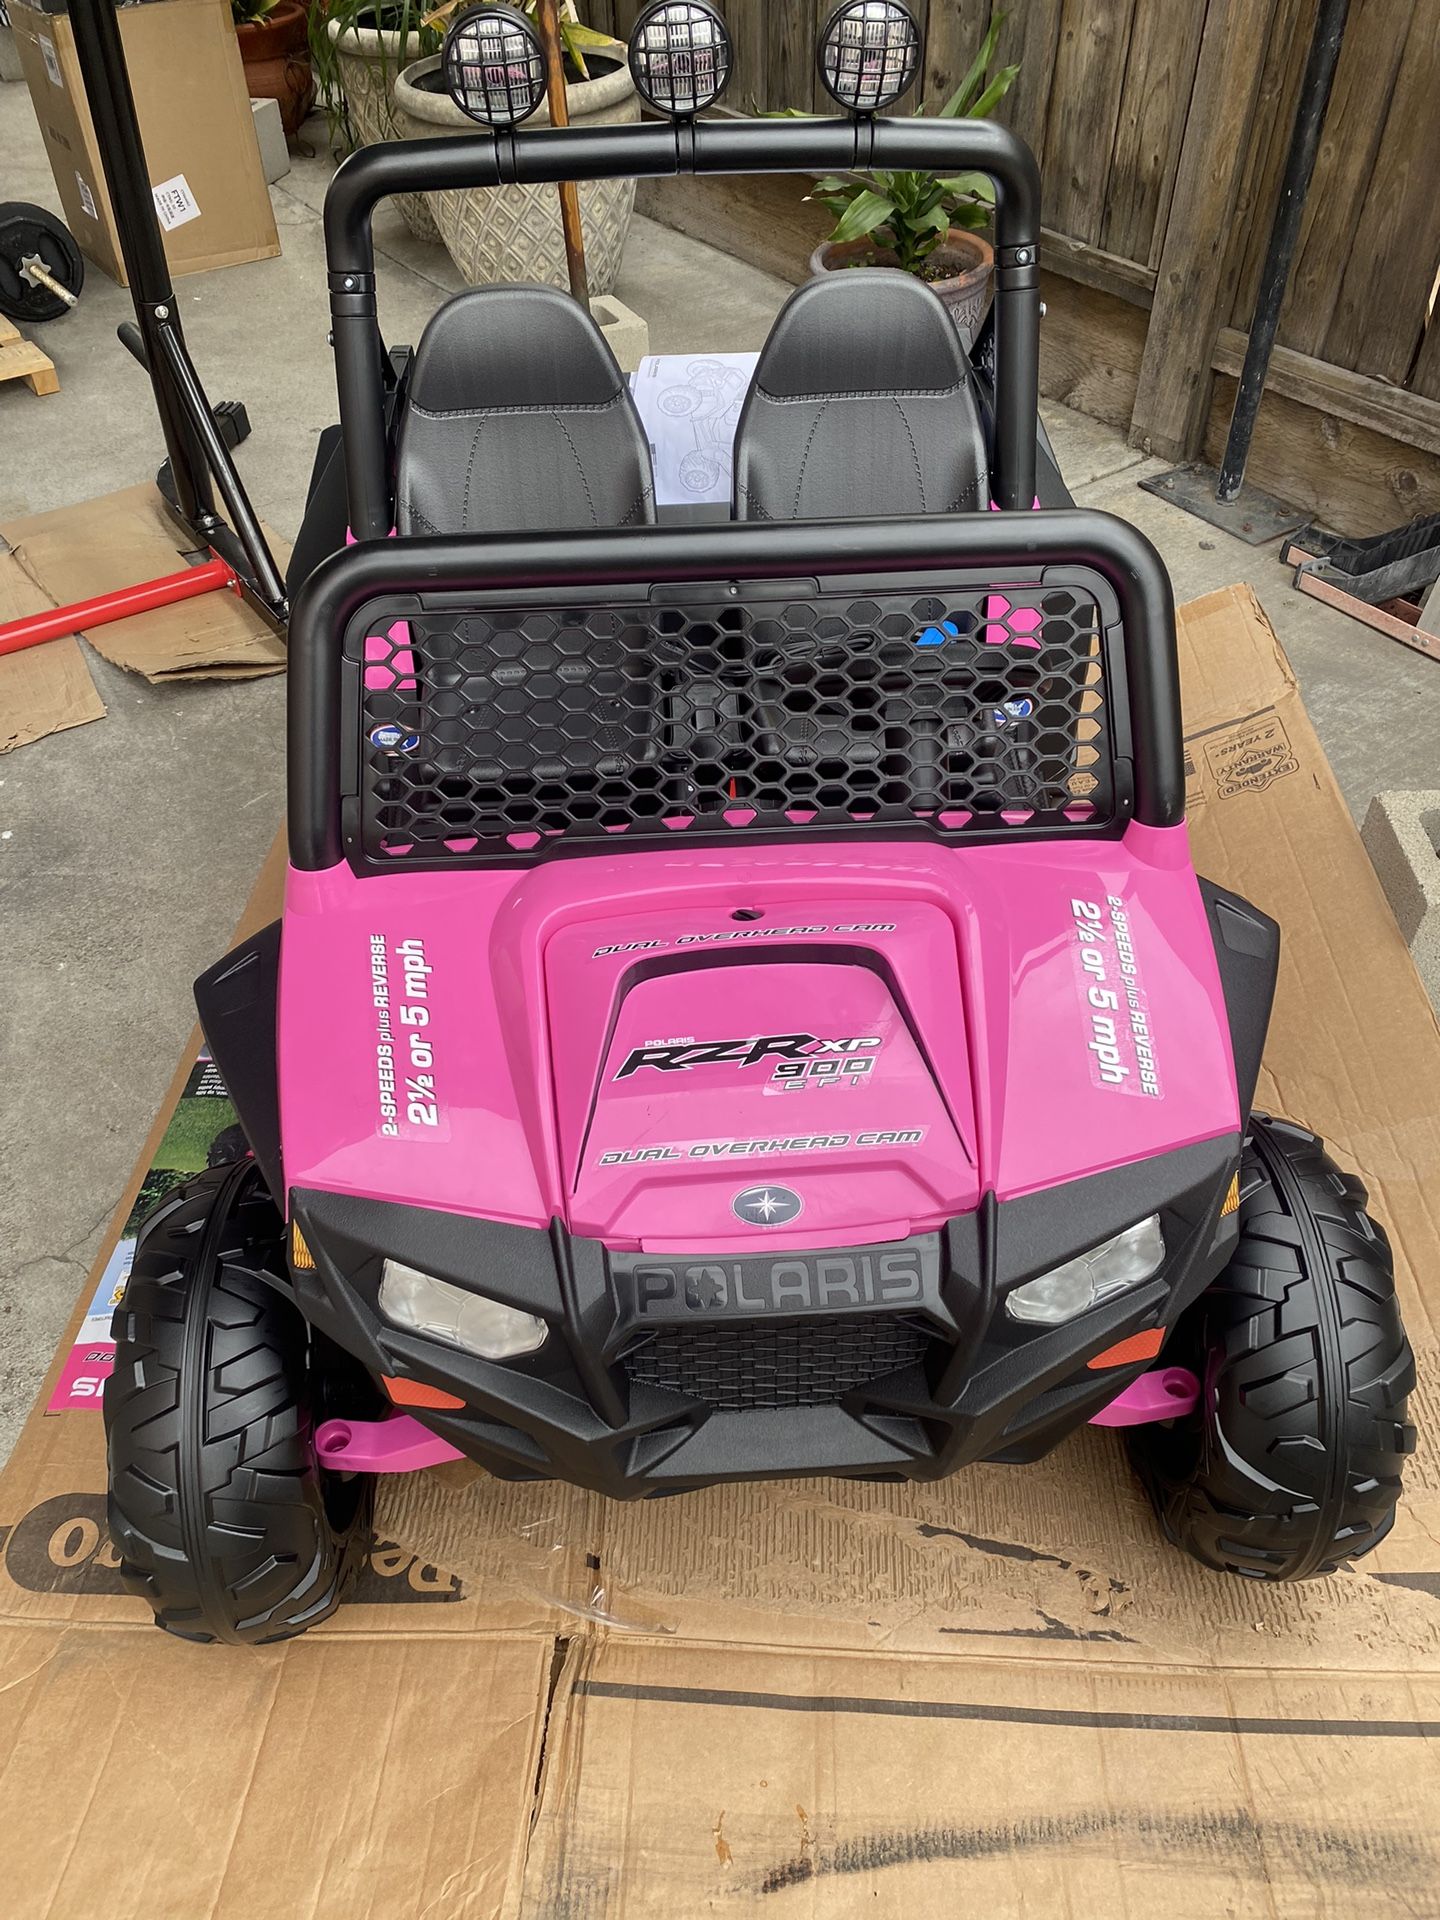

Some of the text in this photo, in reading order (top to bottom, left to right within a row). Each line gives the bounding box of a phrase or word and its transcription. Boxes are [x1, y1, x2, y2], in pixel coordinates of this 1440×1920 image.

[171, 189, 186, 212] FTW1
[1264, 728, 1275, 739] 2
[1220, 744, 1284, 776] WARRANTY
[1226, 762, 1290, 795] EXTENDED
[592, 922, 898, 958] DUAL OVERHEAD CAM
[395, 937, 433, 999] mph
[1080, 948, 1107, 983] or
[1088, 986, 1119, 1011] 5
[1120, 975, 1140, 1008] plus
[400, 1005, 431, 1027] 5
[370, 934, 400, 1137] 2-SPEEDS plus REVERSE
[408, 1032, 435, 1069] or
[645, 1036, 695, 1047] POLARIS
[1088, 1015, 1130, 1085] mph
[1128, 1009, 1160, 1096] REVERSE
[612, 1033, 882, 1082] RZR XP
[771, 1056, 875, 1081] 900
[599, 1130, 923, 1166] DUAL OVERHEAD CAM
[635, 1253, 923, 1316] POLARIS
